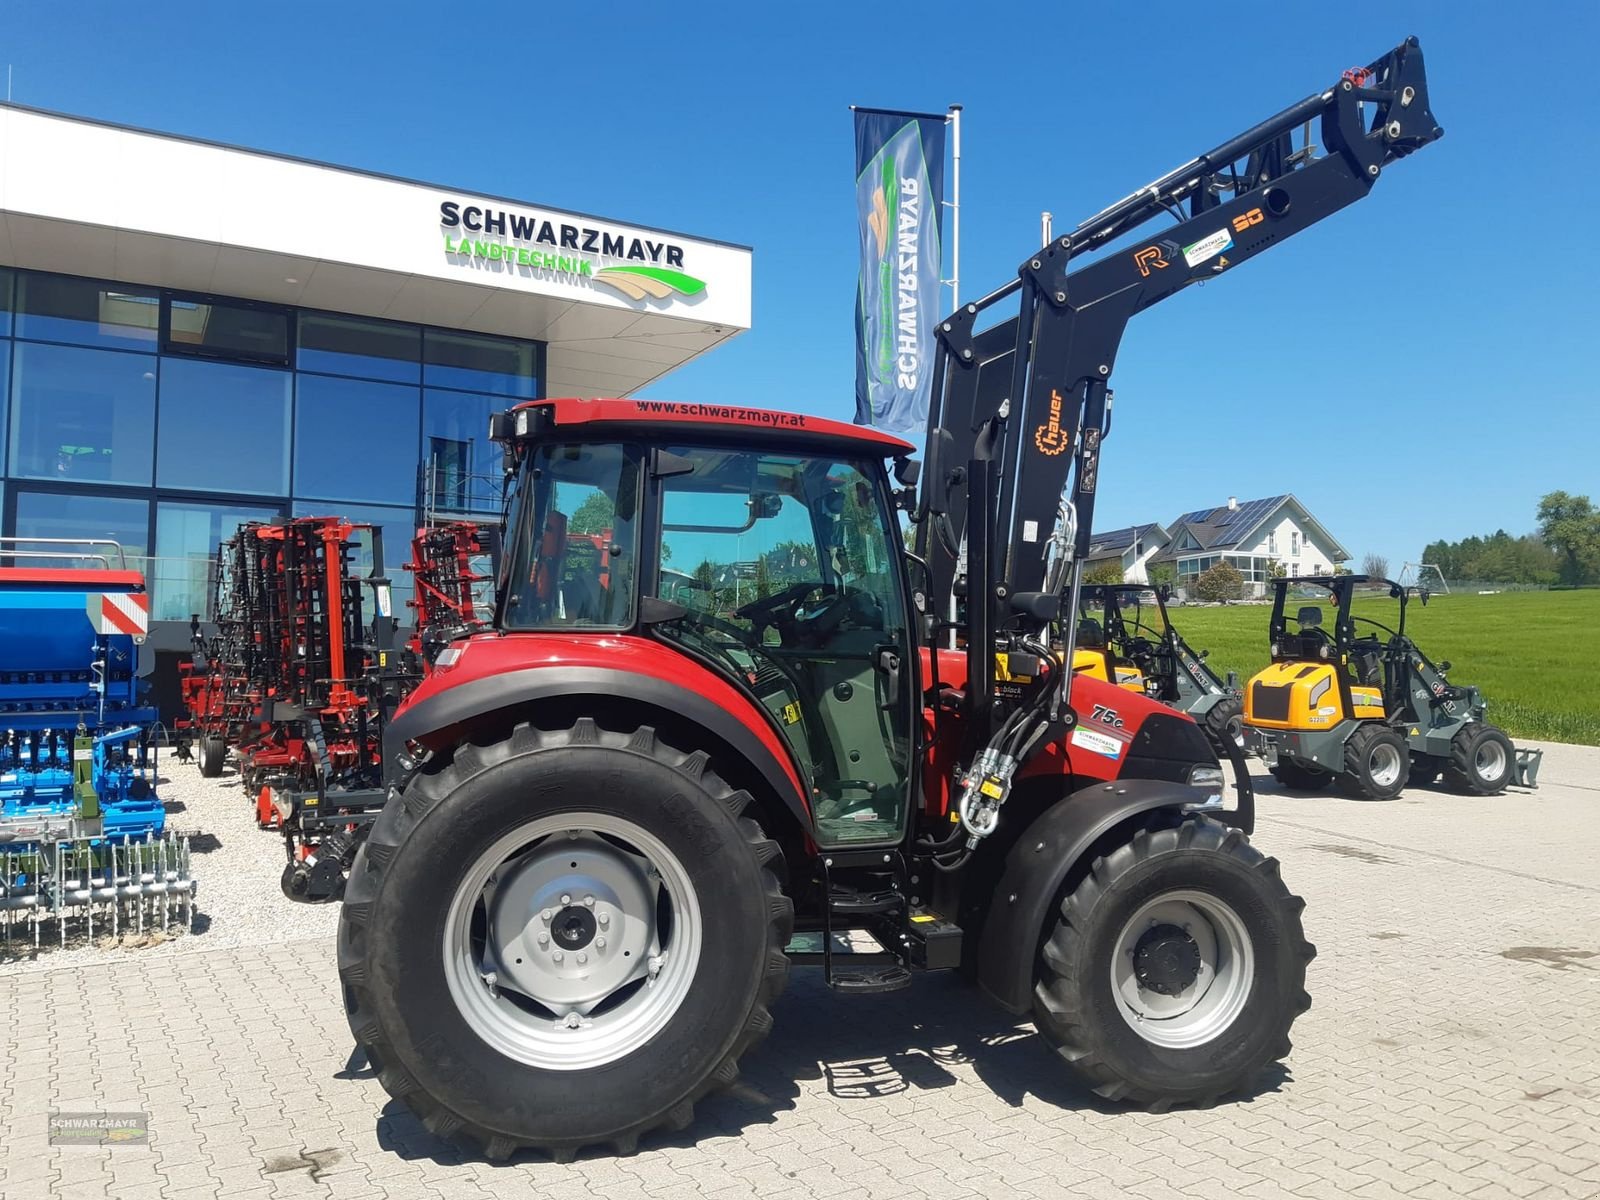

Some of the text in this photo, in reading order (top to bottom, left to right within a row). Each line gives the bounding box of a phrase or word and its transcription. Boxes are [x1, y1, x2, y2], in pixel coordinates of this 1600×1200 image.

[440, 201, 684, 268] SCHWARZMAYR
[445, 234, 593, 276] LANDTECHNIK
[637, 401, 805, 426] www.schwarzmayr.at
[1042, 389, 1062, 446] hauer
